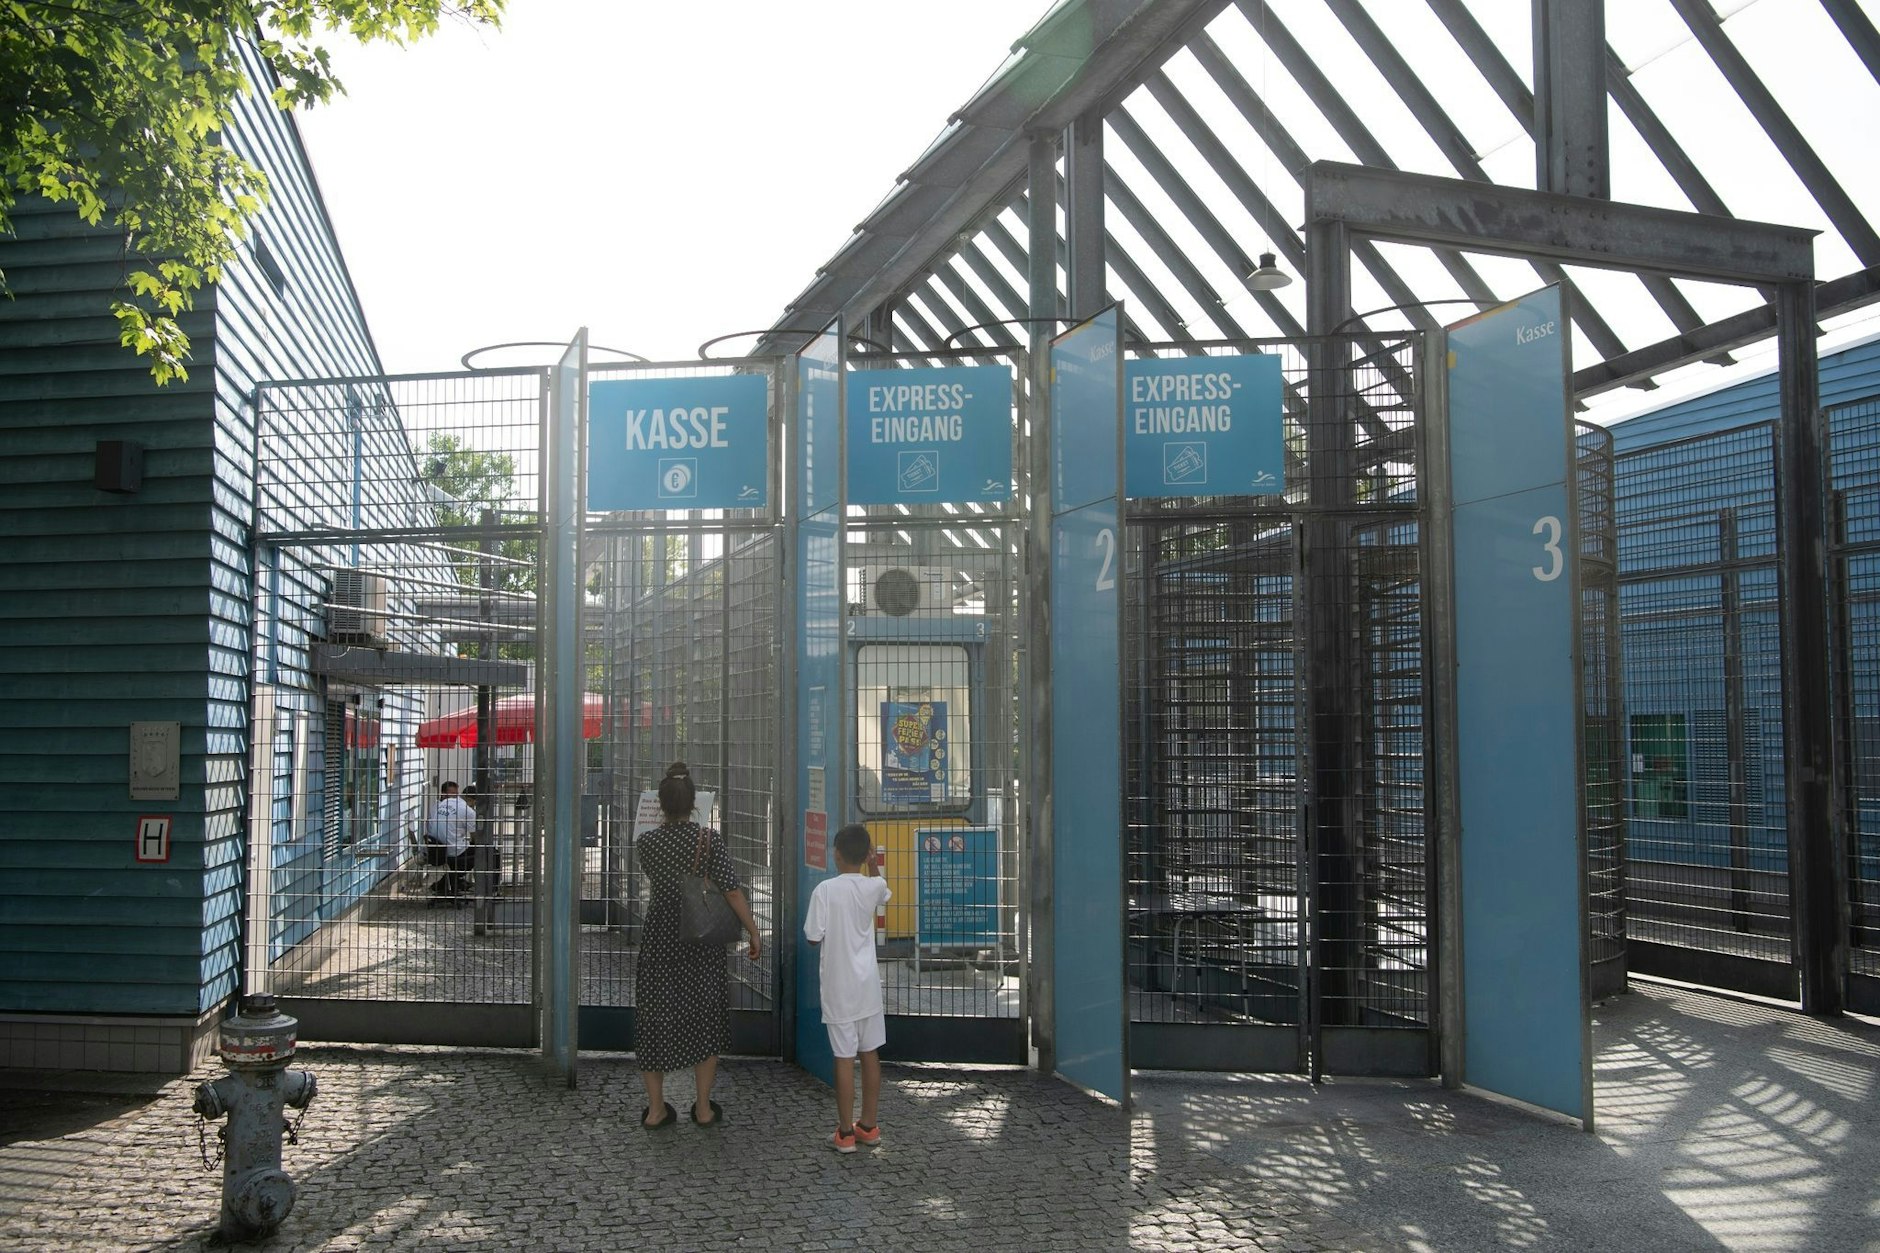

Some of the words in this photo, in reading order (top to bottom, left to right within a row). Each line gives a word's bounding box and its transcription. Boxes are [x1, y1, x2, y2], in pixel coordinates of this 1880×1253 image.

[1516, 320, 1555, 345] Kasse
[869, 383, 973, 412] EXPRESS-
[1132, 373, 1241, 403] EXPRESS-
[625, 406, 729, 450] KASSE
[871, 415, 963, 444] EINGANG
[1135, 405, 1232, 435] EINGANG
[1095, 528, 1114, 592] 2
[1532, 515, 1563, 581] 3
[847, 620, 856, 635] 2
[976, 622, 985, 638] 3
[143, 823, 163, 855] H
